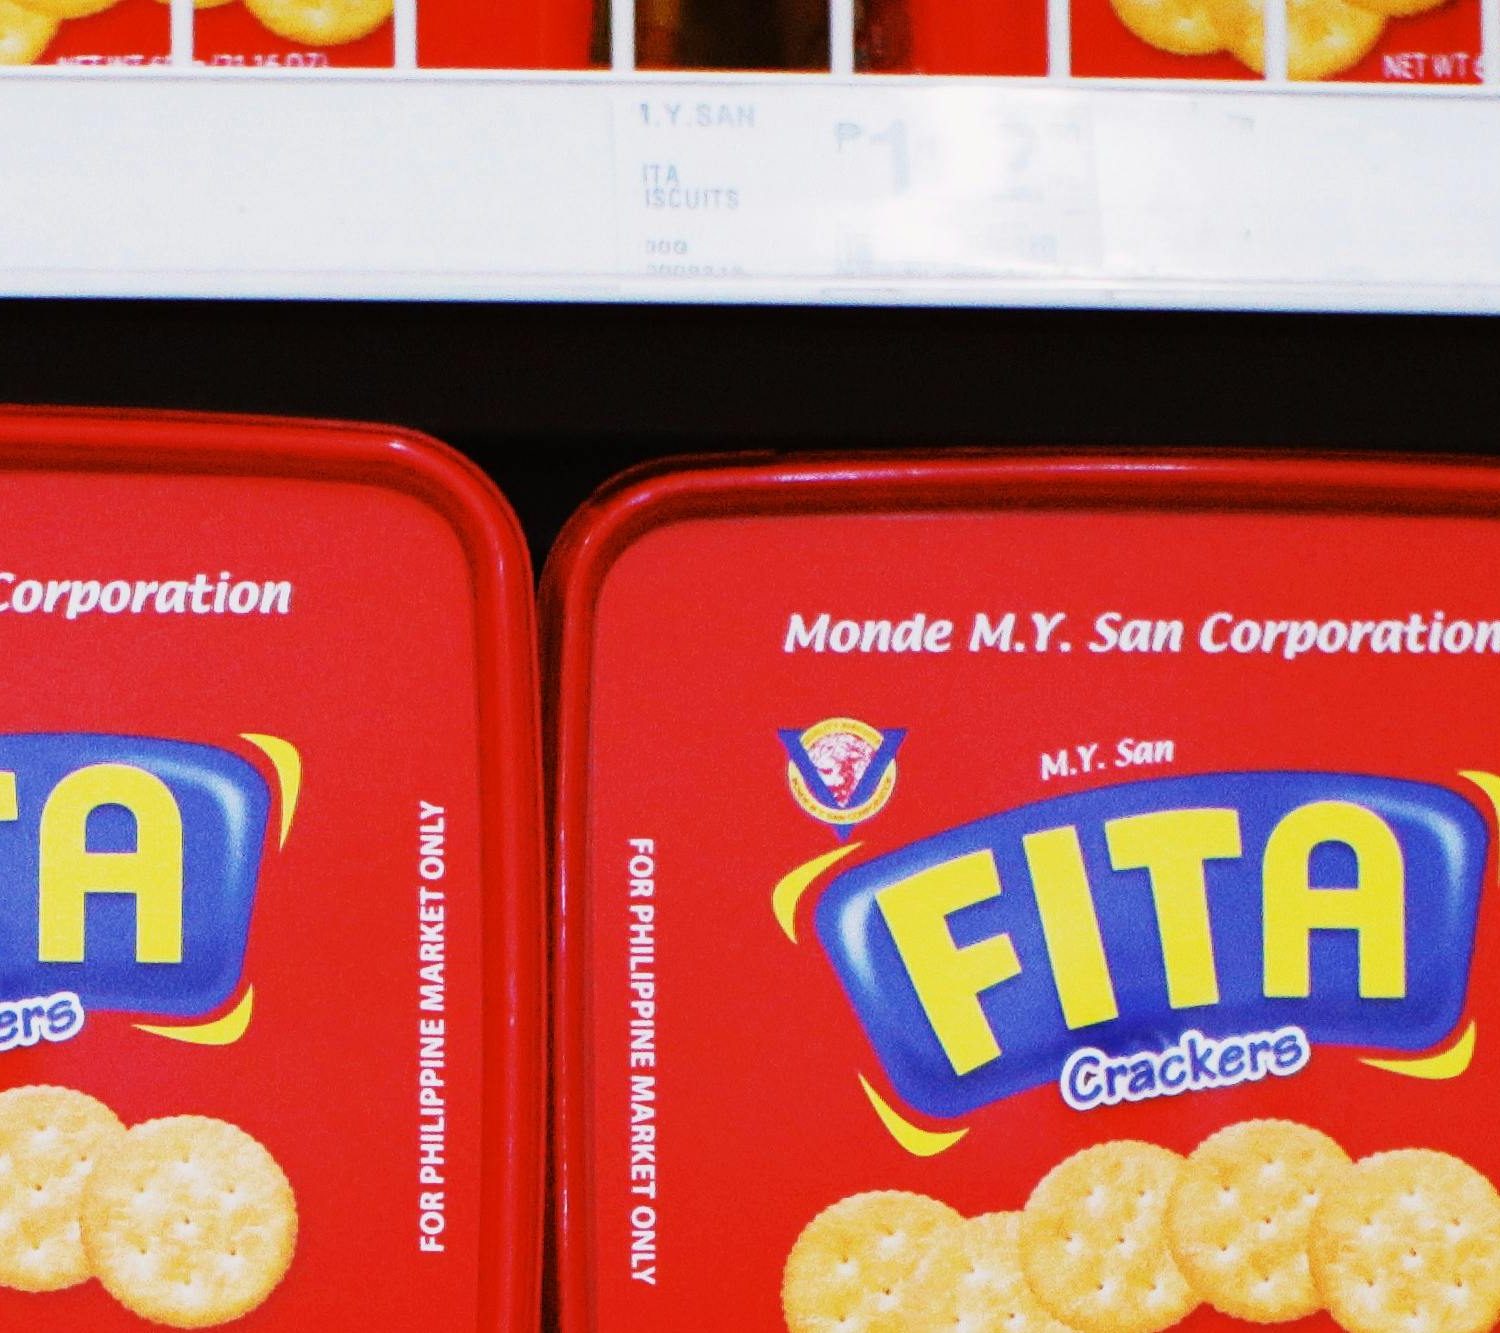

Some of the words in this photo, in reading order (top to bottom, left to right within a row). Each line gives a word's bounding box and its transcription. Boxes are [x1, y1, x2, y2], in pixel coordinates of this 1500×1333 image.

[1384, 52, 1426, 79] NET
[1433, 52, 1468, 77] WT
[784, 613, 953, 653] Monde
[967, 612, 1074, 656] M.Y.
[1089, 612, 1183, 653] San
[873, 800, 1407, 1078] FITA
[1068, 1030, 1308, 1105] Crackers
